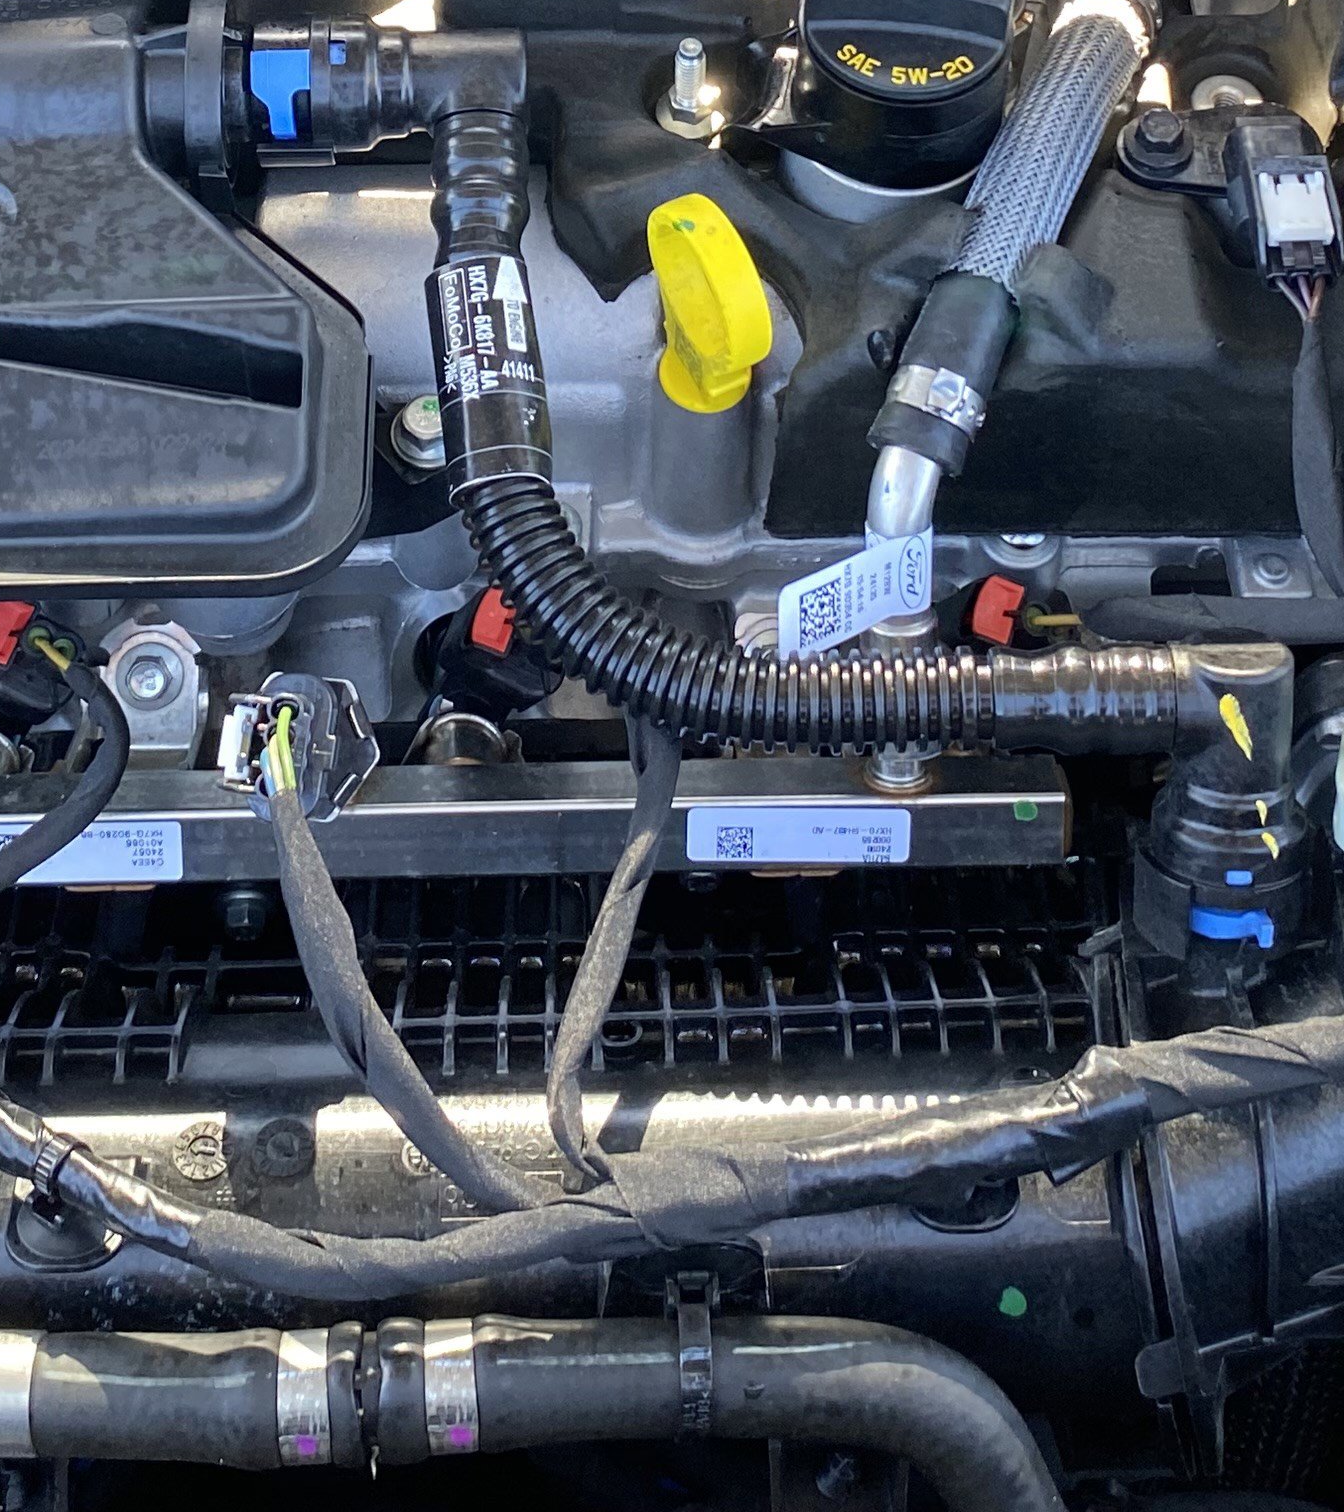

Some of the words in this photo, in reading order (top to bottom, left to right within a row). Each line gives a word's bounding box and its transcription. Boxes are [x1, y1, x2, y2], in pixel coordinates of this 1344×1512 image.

[835, 43, 883, 79] SAE
[890, 54, 975, 86] 5W-20
[442, 273, 464, 349] FoMoCo
[500, 359, 536, 383] 41411
[905, 548, 923, 597] Ford
